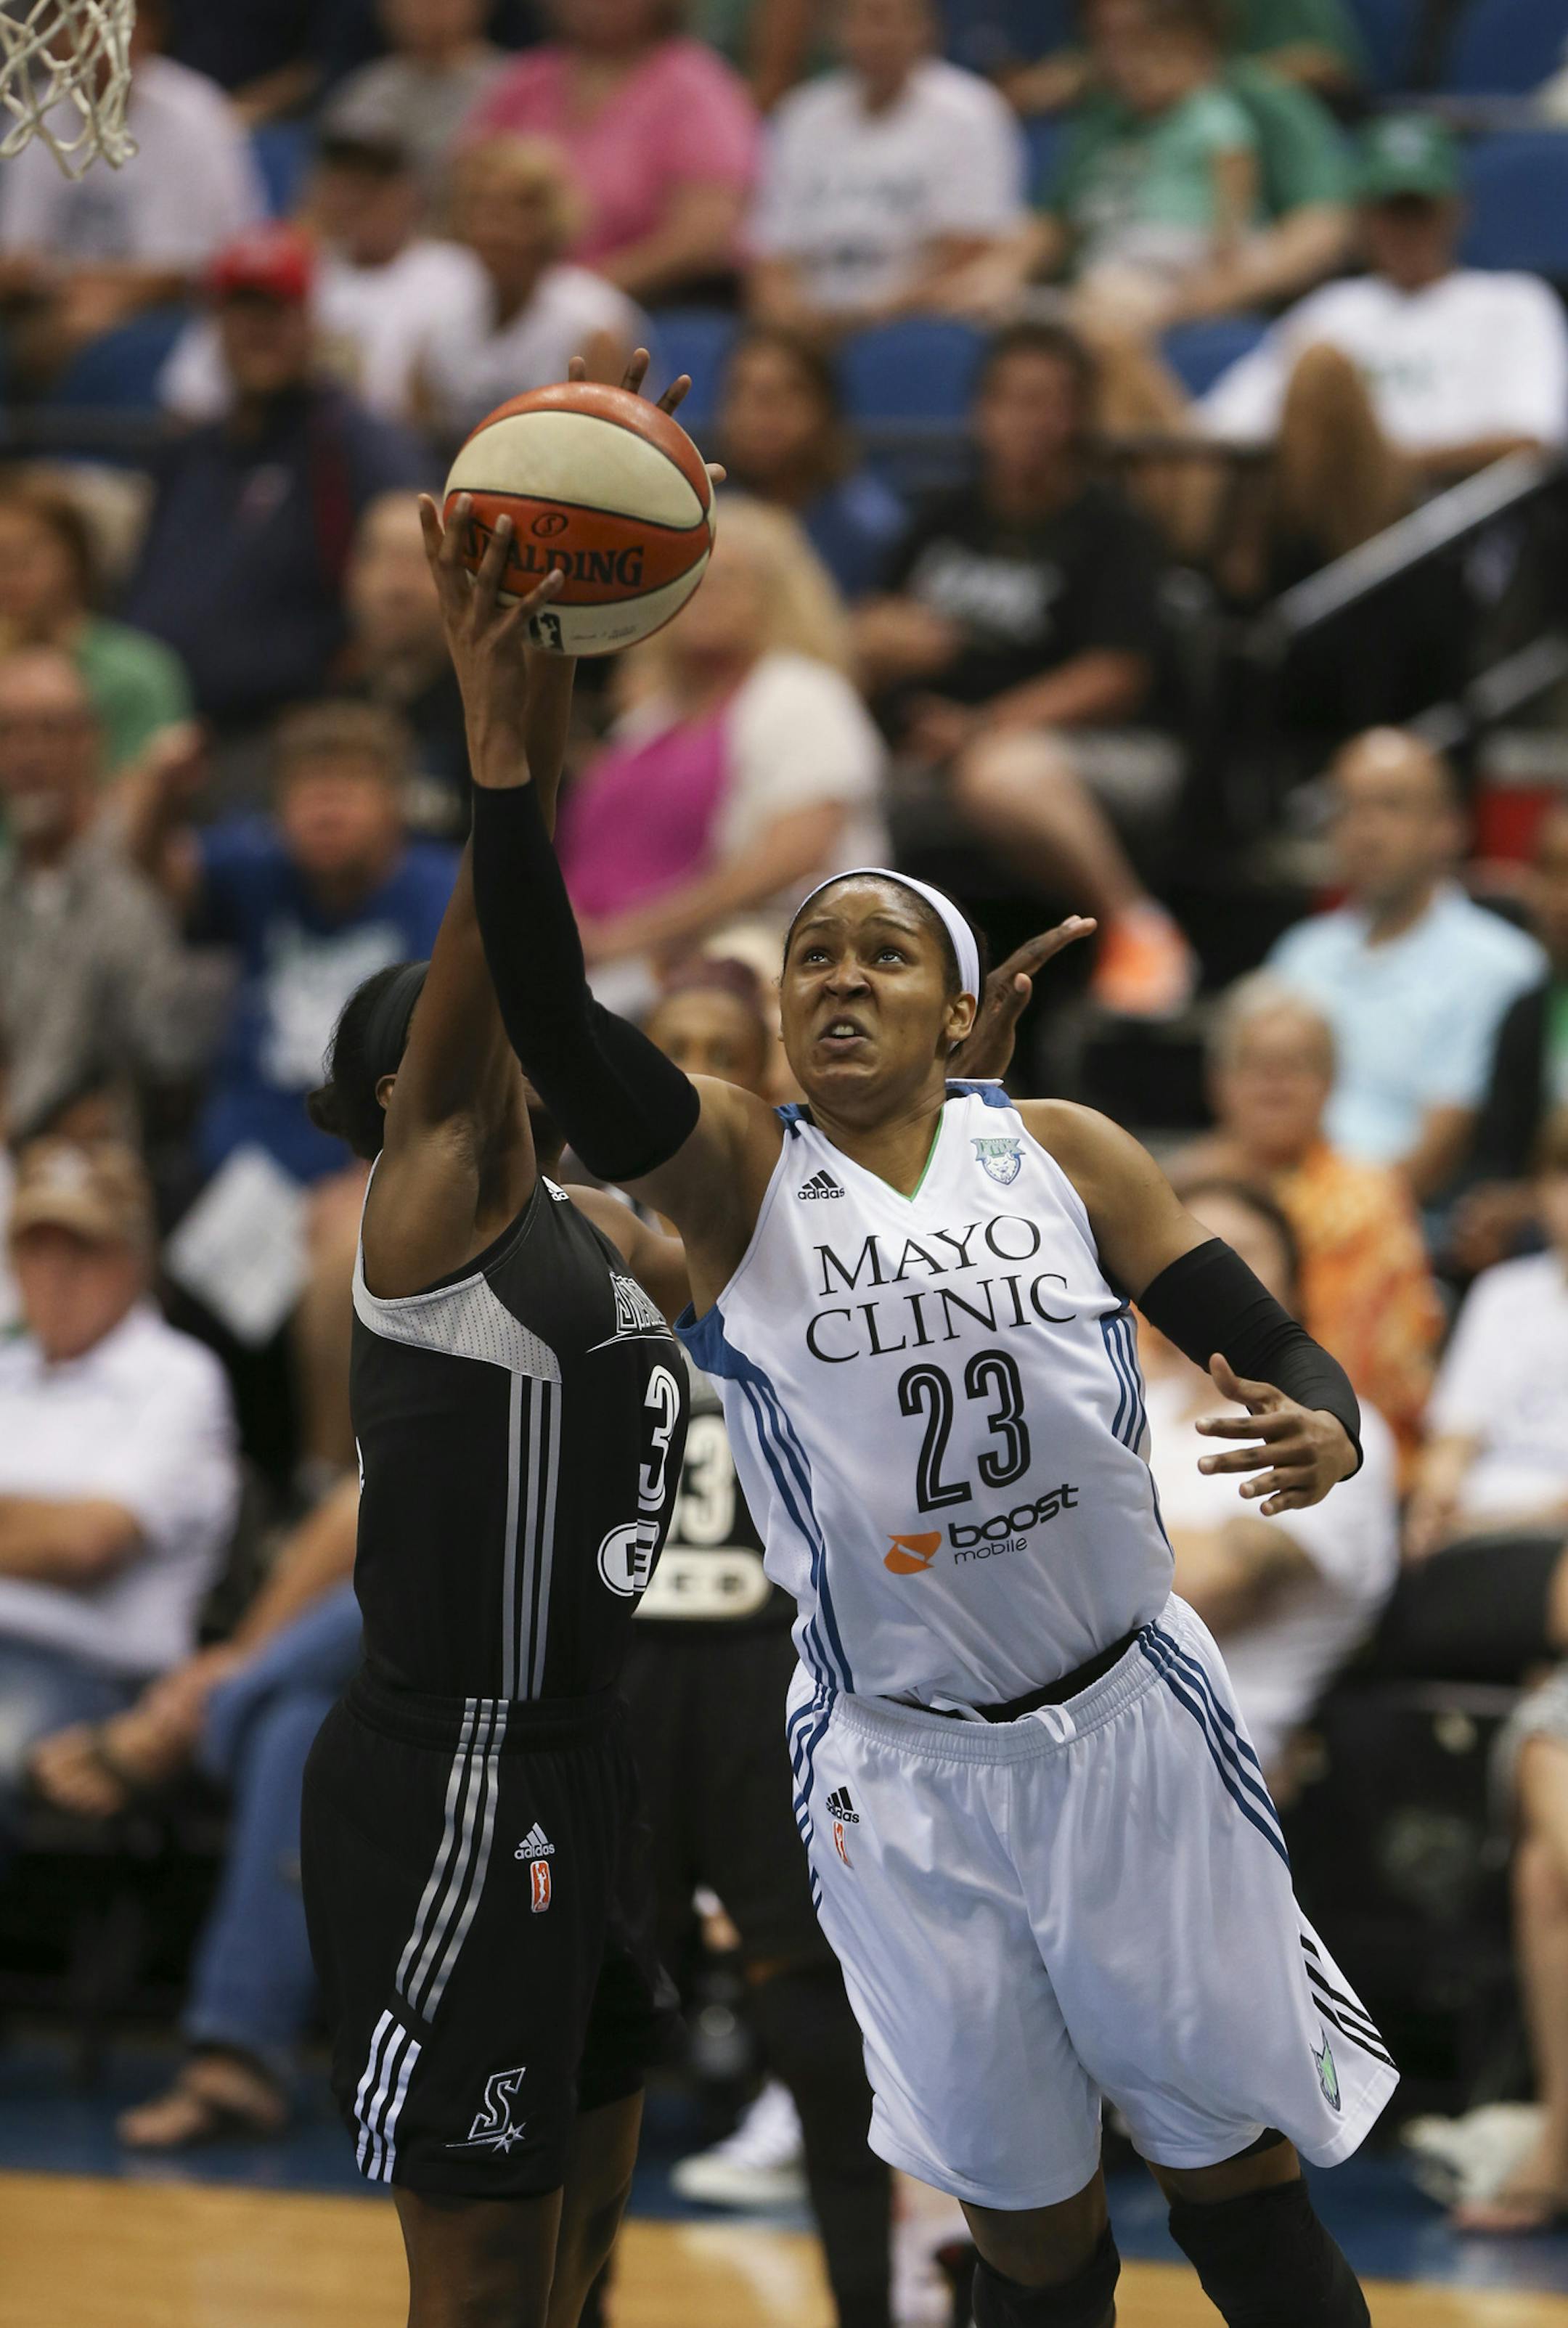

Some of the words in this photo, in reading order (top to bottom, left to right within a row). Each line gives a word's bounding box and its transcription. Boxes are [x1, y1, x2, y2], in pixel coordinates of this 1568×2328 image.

[798, 1187, 846, 1200] adidas
[813, 1214, 1041, 1296] MAYO
[806, 1273, 1077, 1363] CLINIC
[897, 1349, 1030, 1513] 23
[948, 1484, 1079, 1548] boost
[954, 1537, 1028, 1565] mobile
[514, 1843, 555, 1860] adidas
